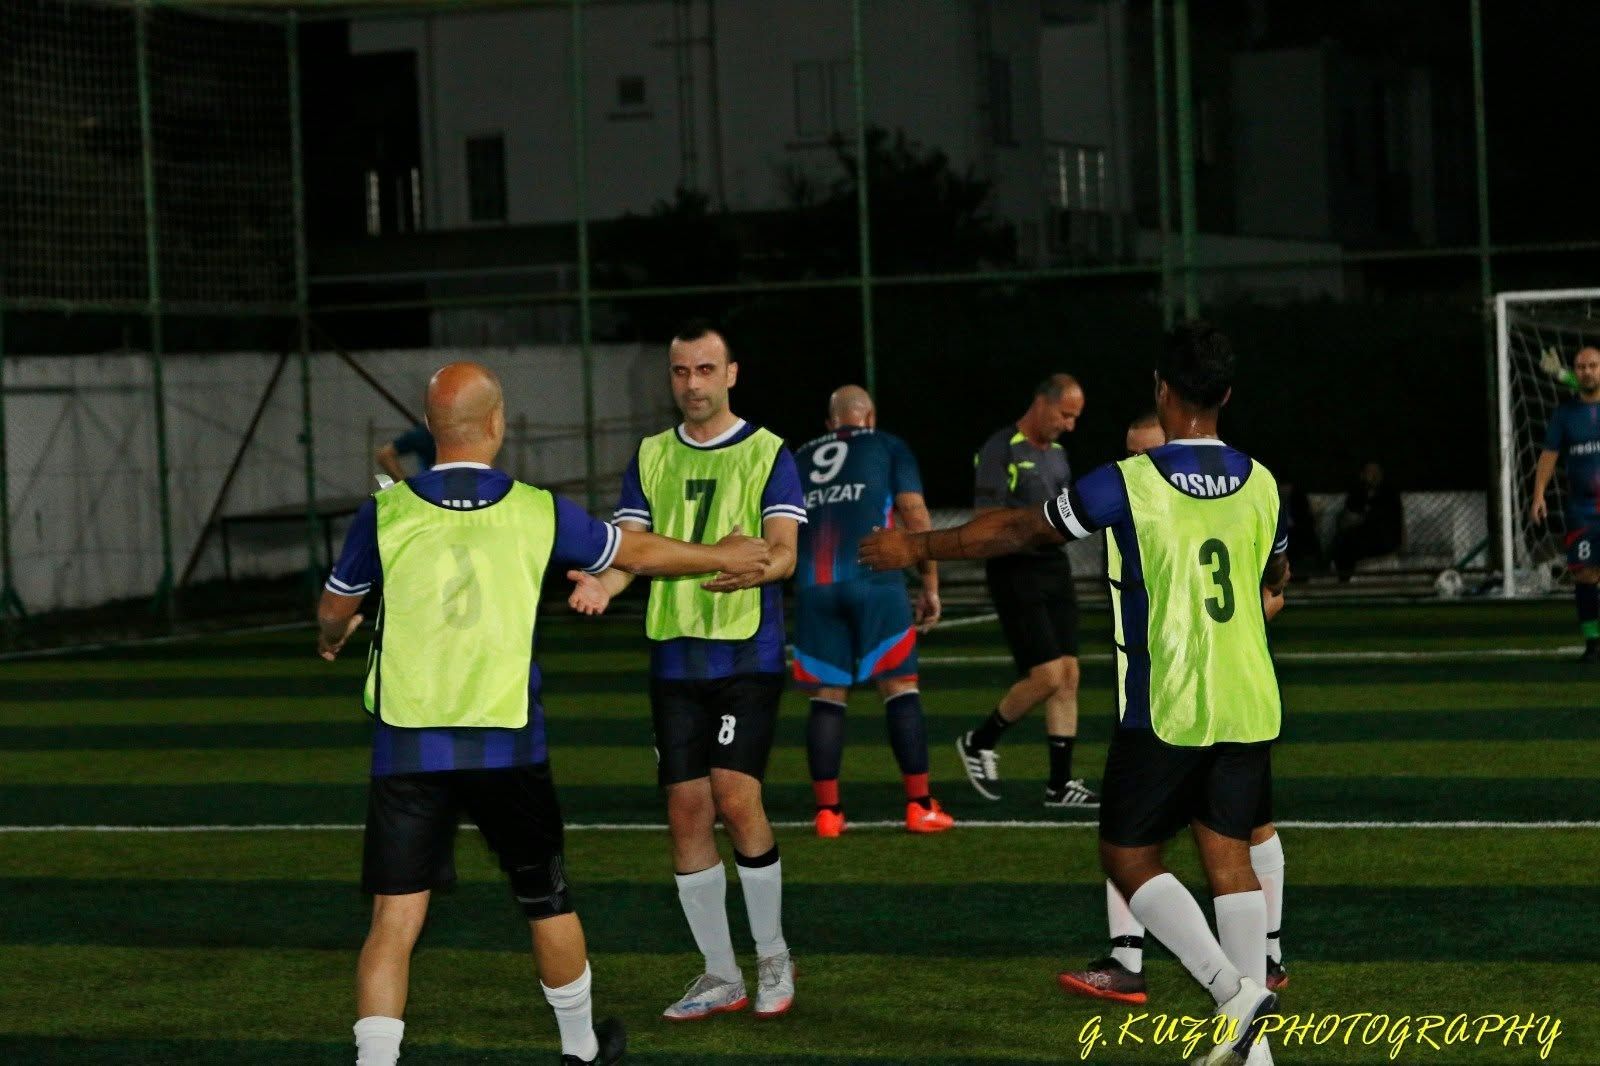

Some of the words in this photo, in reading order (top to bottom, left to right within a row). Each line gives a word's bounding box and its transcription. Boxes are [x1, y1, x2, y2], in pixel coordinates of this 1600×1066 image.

[809, 440, 848, 483] 9
[685, 478, 717, 544] 7
[1578, 540, 1591, 560] 8
[1199, 538, 1235, 623] 3
[717, 713, 737, 745] 8
